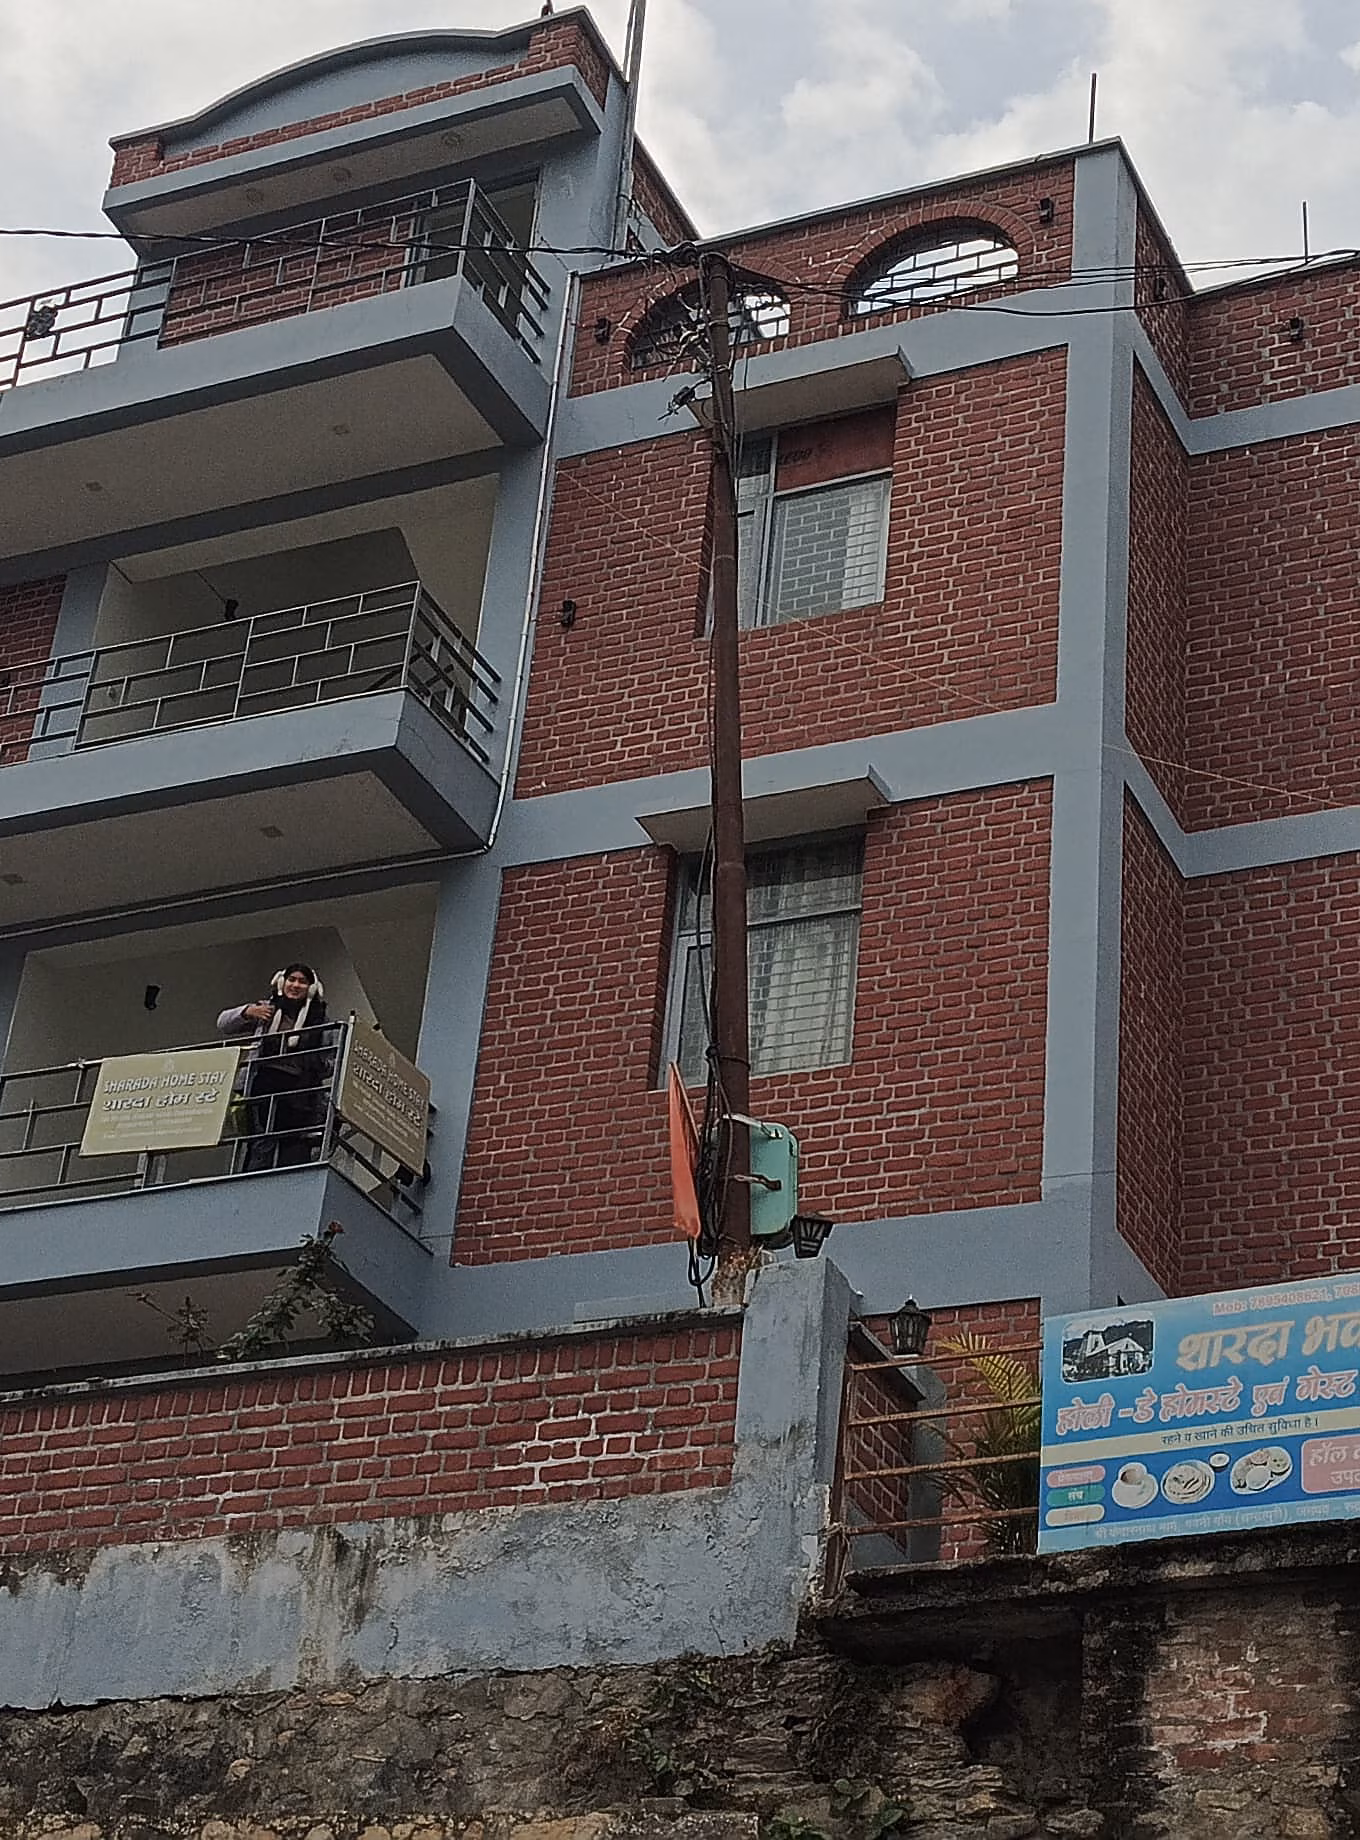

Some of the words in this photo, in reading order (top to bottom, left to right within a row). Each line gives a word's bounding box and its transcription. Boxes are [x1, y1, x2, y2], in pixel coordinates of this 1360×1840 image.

[104, 1077, 157, 1094] SHARADA
[160, 1073, 195, 1088] HOME
[198, 1070, 228, 1085] STAY
[103, 1094, 151, 1111] शारदा
[157, 1089, 192, 1109] होम
[195, 1088, 220, 1104] स्टे
[1213, 1301, 1247, 1315] Mob:
[1176, 1320, 1295, 1371] शारदा
[1056, 1393, 1115, 1435] होली
[1160, 1376, 1243, 1422] होमस्टे
[1251, 1376, 1290, 1416] एवं
[1296, 1365, 1358, 1401] गेस्ट
[1162, 1432, 1181, 1445] रहने
[1220, 1424, 1234, 1437] की
[1309, 1441, 1347, 1467] हॉल
